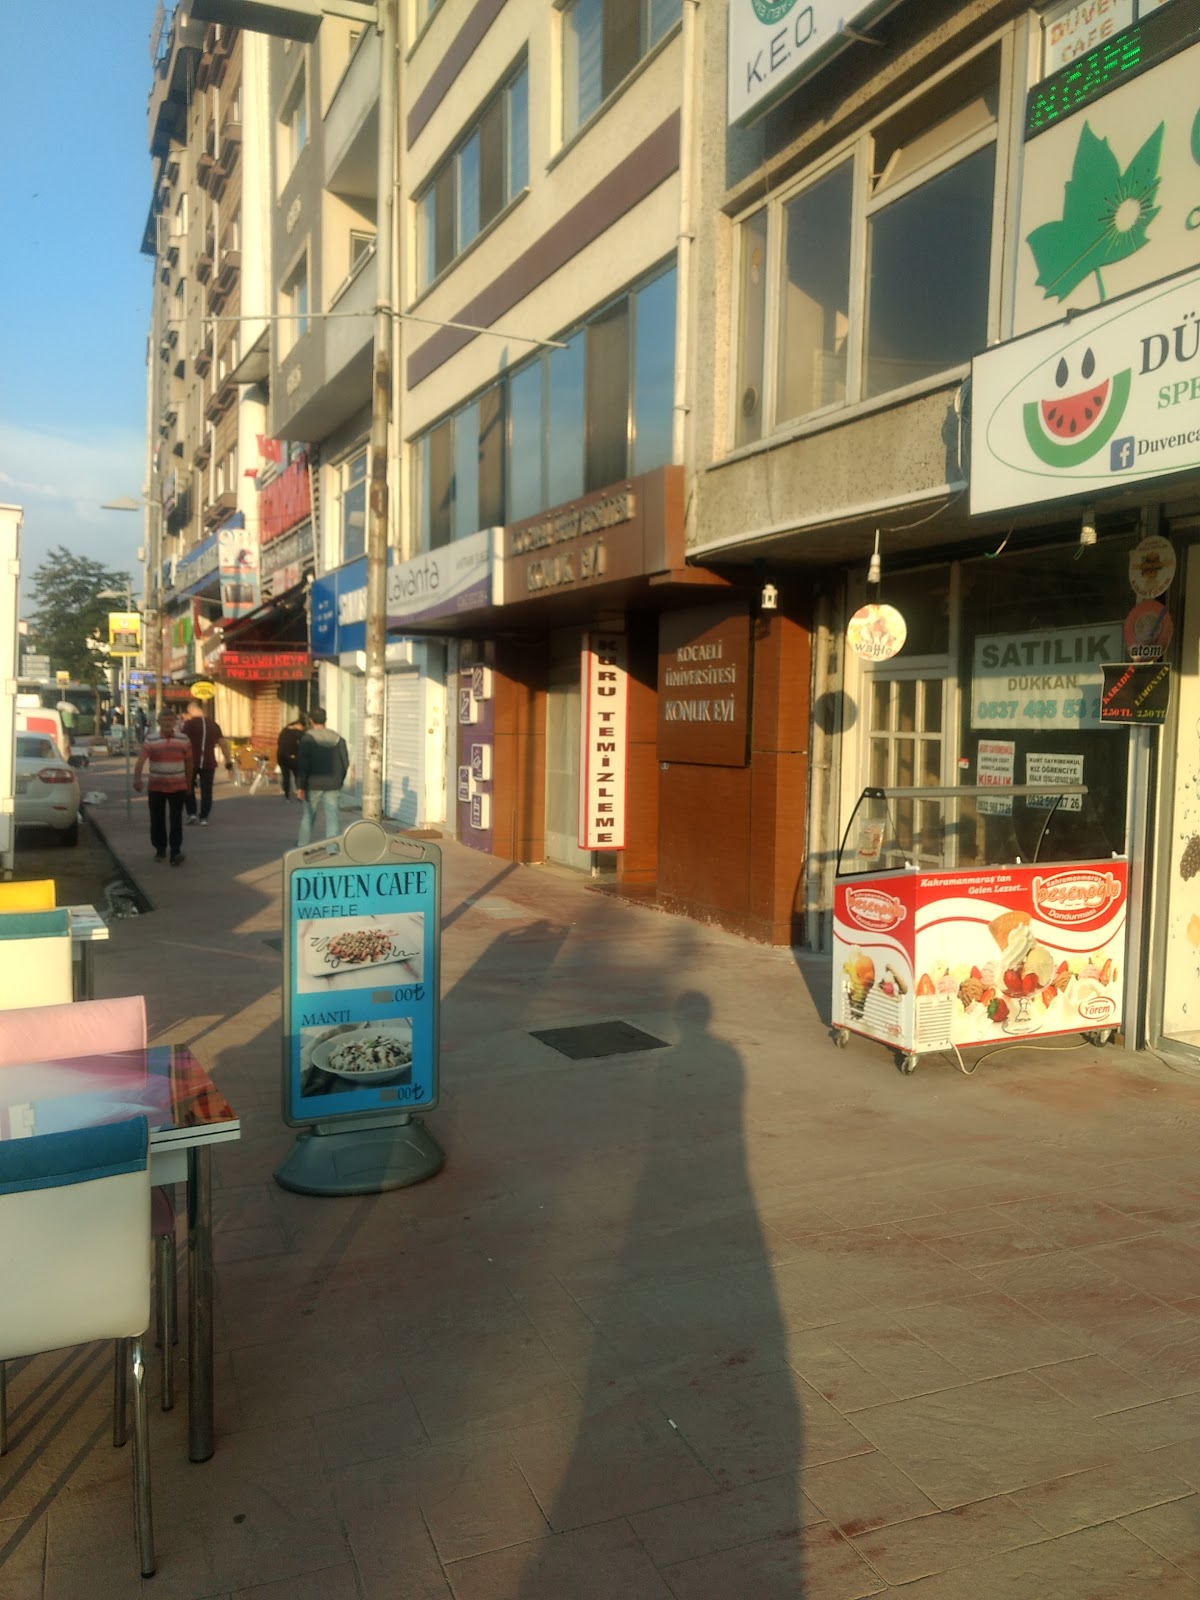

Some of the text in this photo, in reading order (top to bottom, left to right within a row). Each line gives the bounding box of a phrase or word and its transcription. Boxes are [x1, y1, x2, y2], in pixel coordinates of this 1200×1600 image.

[1061, 18, 1114, 62] CAFE
[677, 640, 722, 661] KOCAELİ
[982, 634, 1111, 669] SATILIK
[1131, 645, 1162, 657] atom
[665, 664, 736, 687] ÜNİVERSİTESİ
[1008, 675, 1077, 691] DÜKKAN
[1103, 665, 1136, 705] KARADUT
[665, 693, 734, 722] KONUK EVİ
[596, 640, 617, 843] KURU TEMİZLEME
[978, 772, 1012, 785] KİRALIK
[1070, 798, 1080, 810] 26
[296, 870, 428, 901] DÜVEN CAFE
[968, 886, 992, 895] Gelen
[297, 904, 358, 919] WAFFLE
[301, 1009, 351, 1025] MANTI
